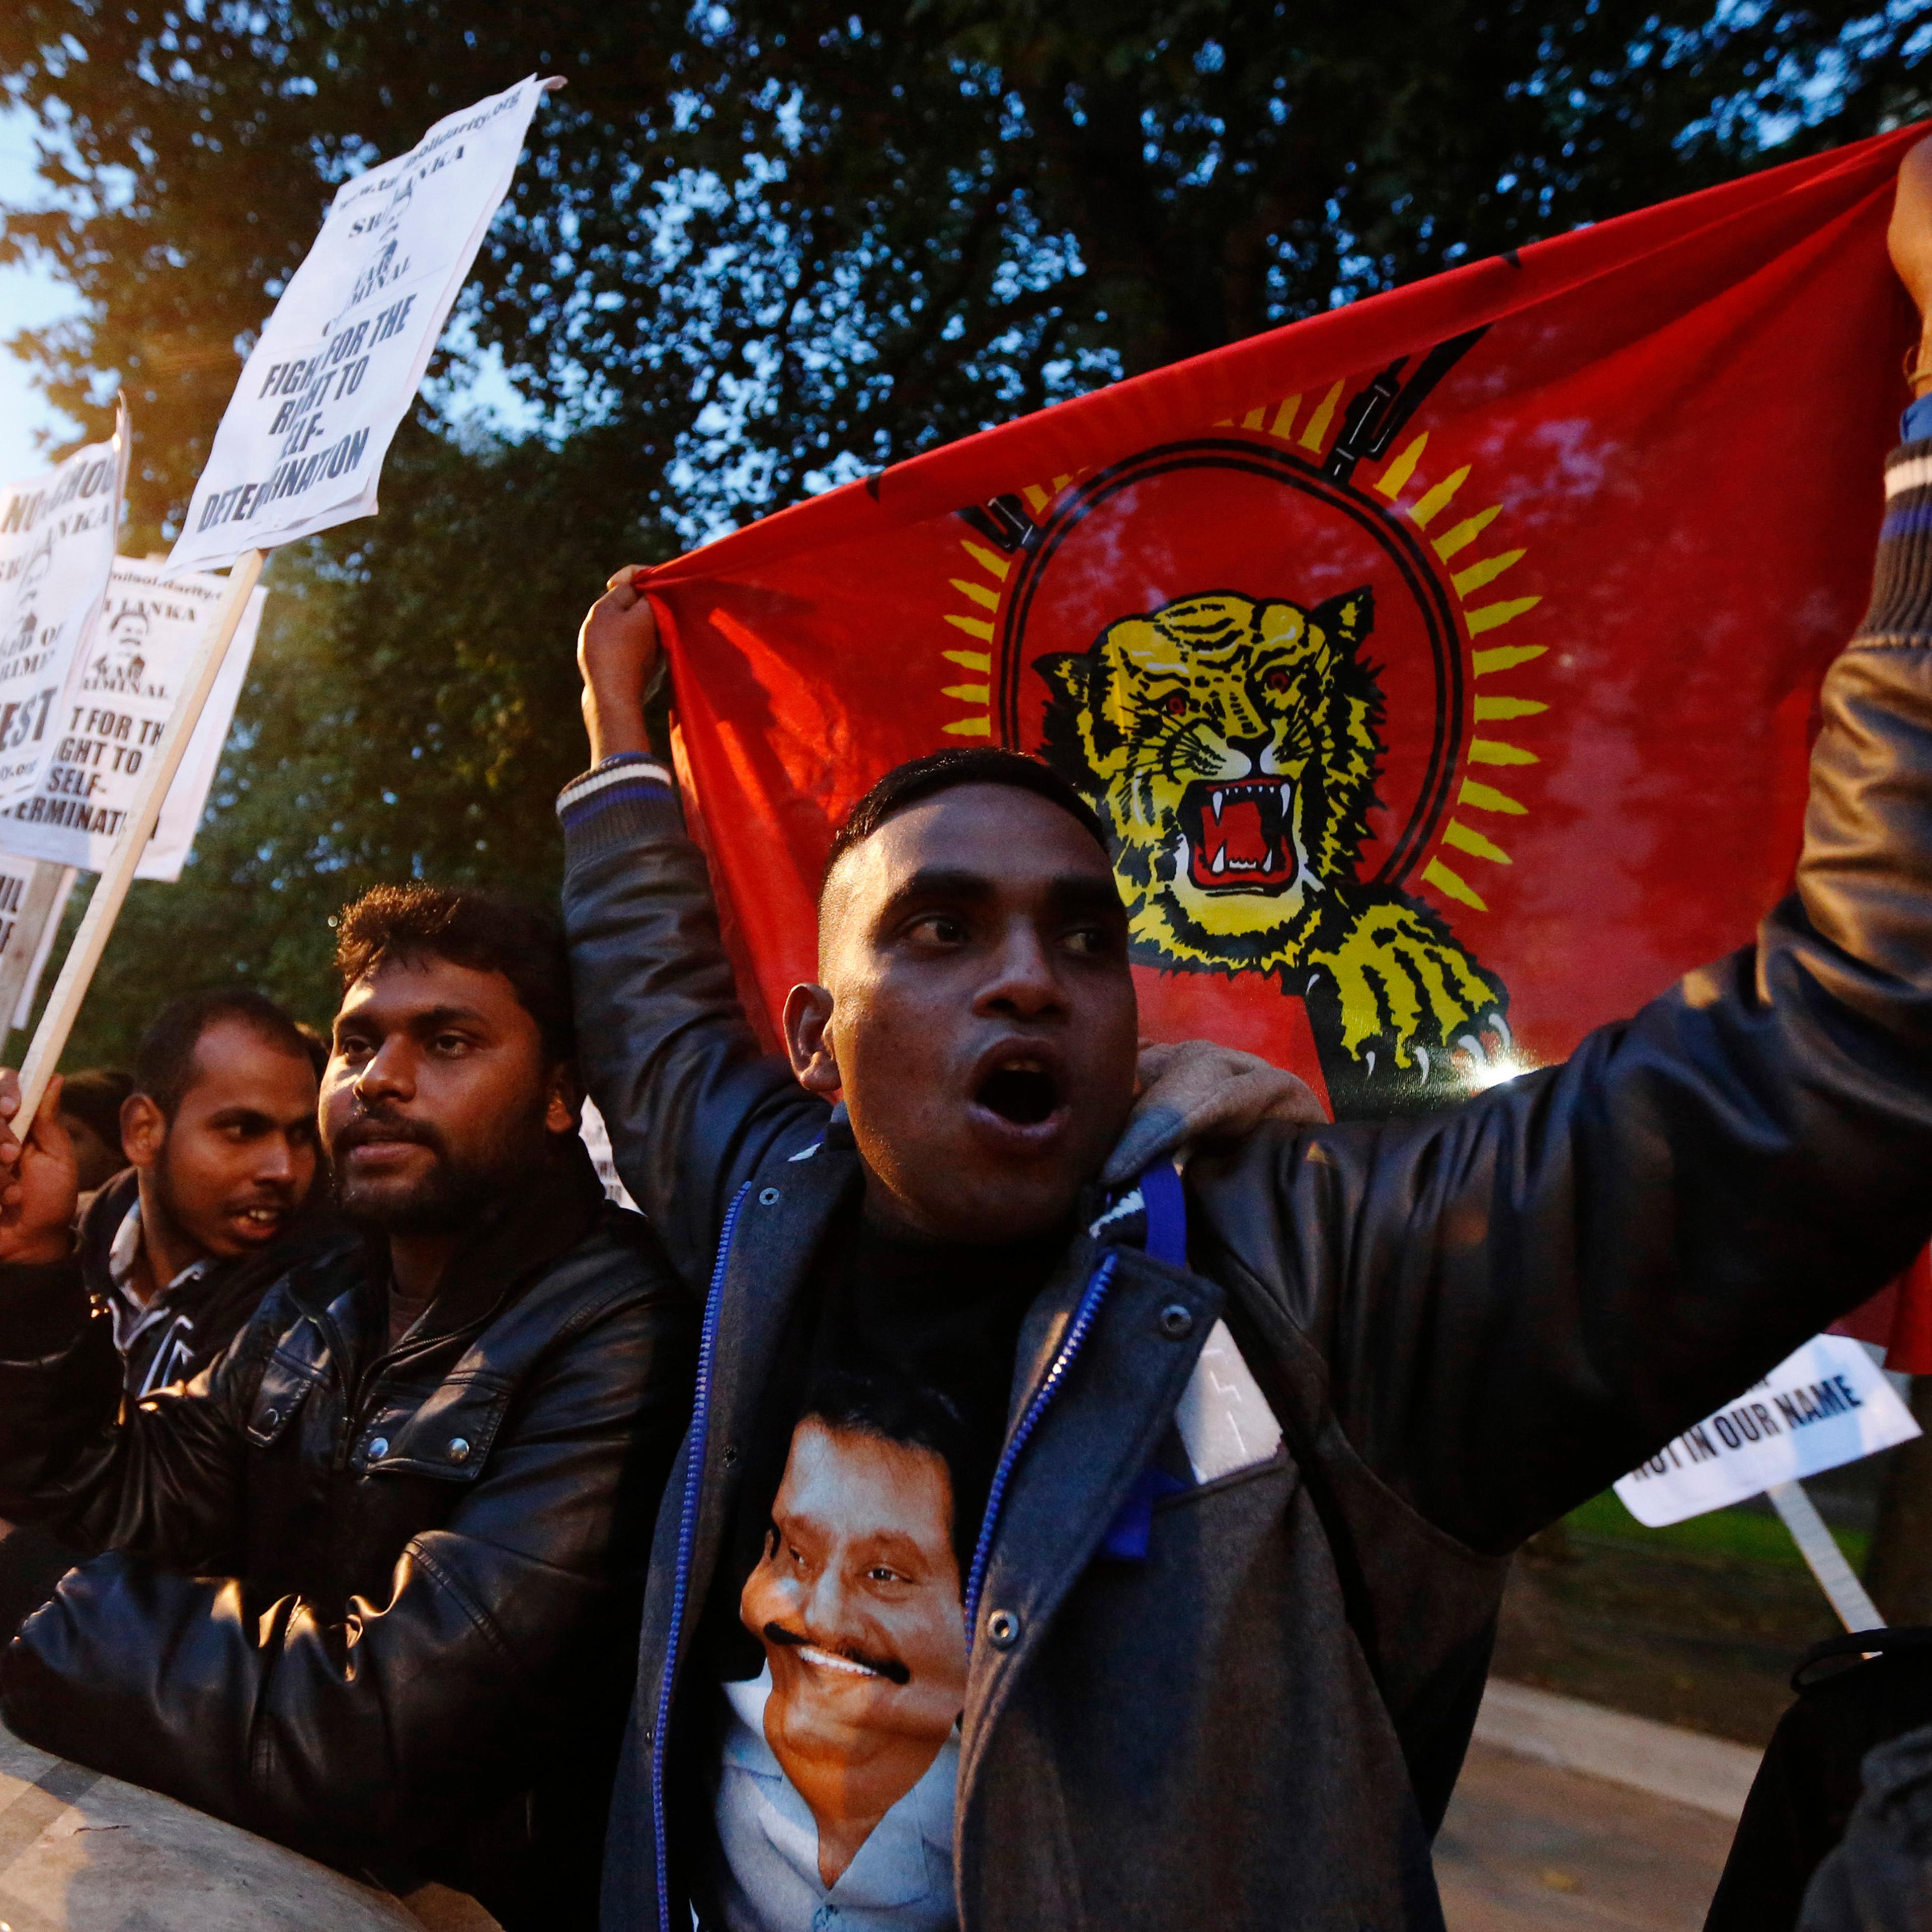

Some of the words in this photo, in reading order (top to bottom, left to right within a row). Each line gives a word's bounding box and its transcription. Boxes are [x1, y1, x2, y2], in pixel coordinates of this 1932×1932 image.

[320, 319, 370, 370] FOR
[367, 292, 417, 349] THE
[334, 354, 370, 401] TO
[280, 411, 325, 459] ELF-
[84, 708, 132, 741] FOR
[138, 718, 166, 747] TH
[46, 767, 107, 797] SELF-
[111, 746, 143, 776] TO
[1680, 1423, 1717, 1463] IN
[1713, 1403, 1782, 1449] OUR
[1773, 1374, 1863, 1430] NAME
